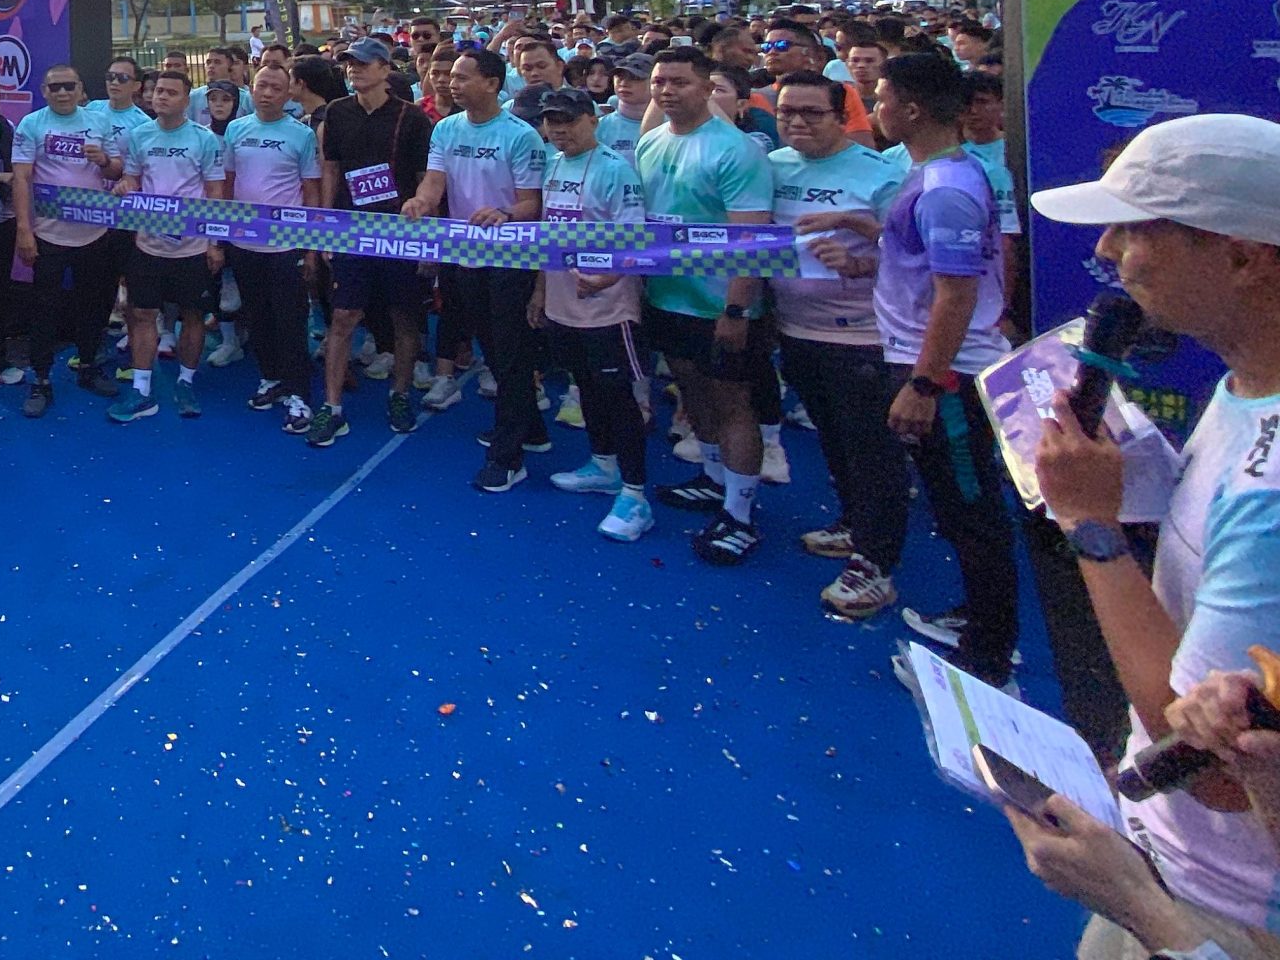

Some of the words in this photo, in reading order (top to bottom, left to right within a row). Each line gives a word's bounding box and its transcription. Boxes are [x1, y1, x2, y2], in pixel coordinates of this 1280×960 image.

[358, 176, 389, 193] 2149
[120, 196, 180, 214] FINISH
[61, 207, 116, 225] FINISH
[448, 223, 536, 243] FINISH
[358, 237, 440, 260] FINISH
[580, 255, 610, 264] SGCY
